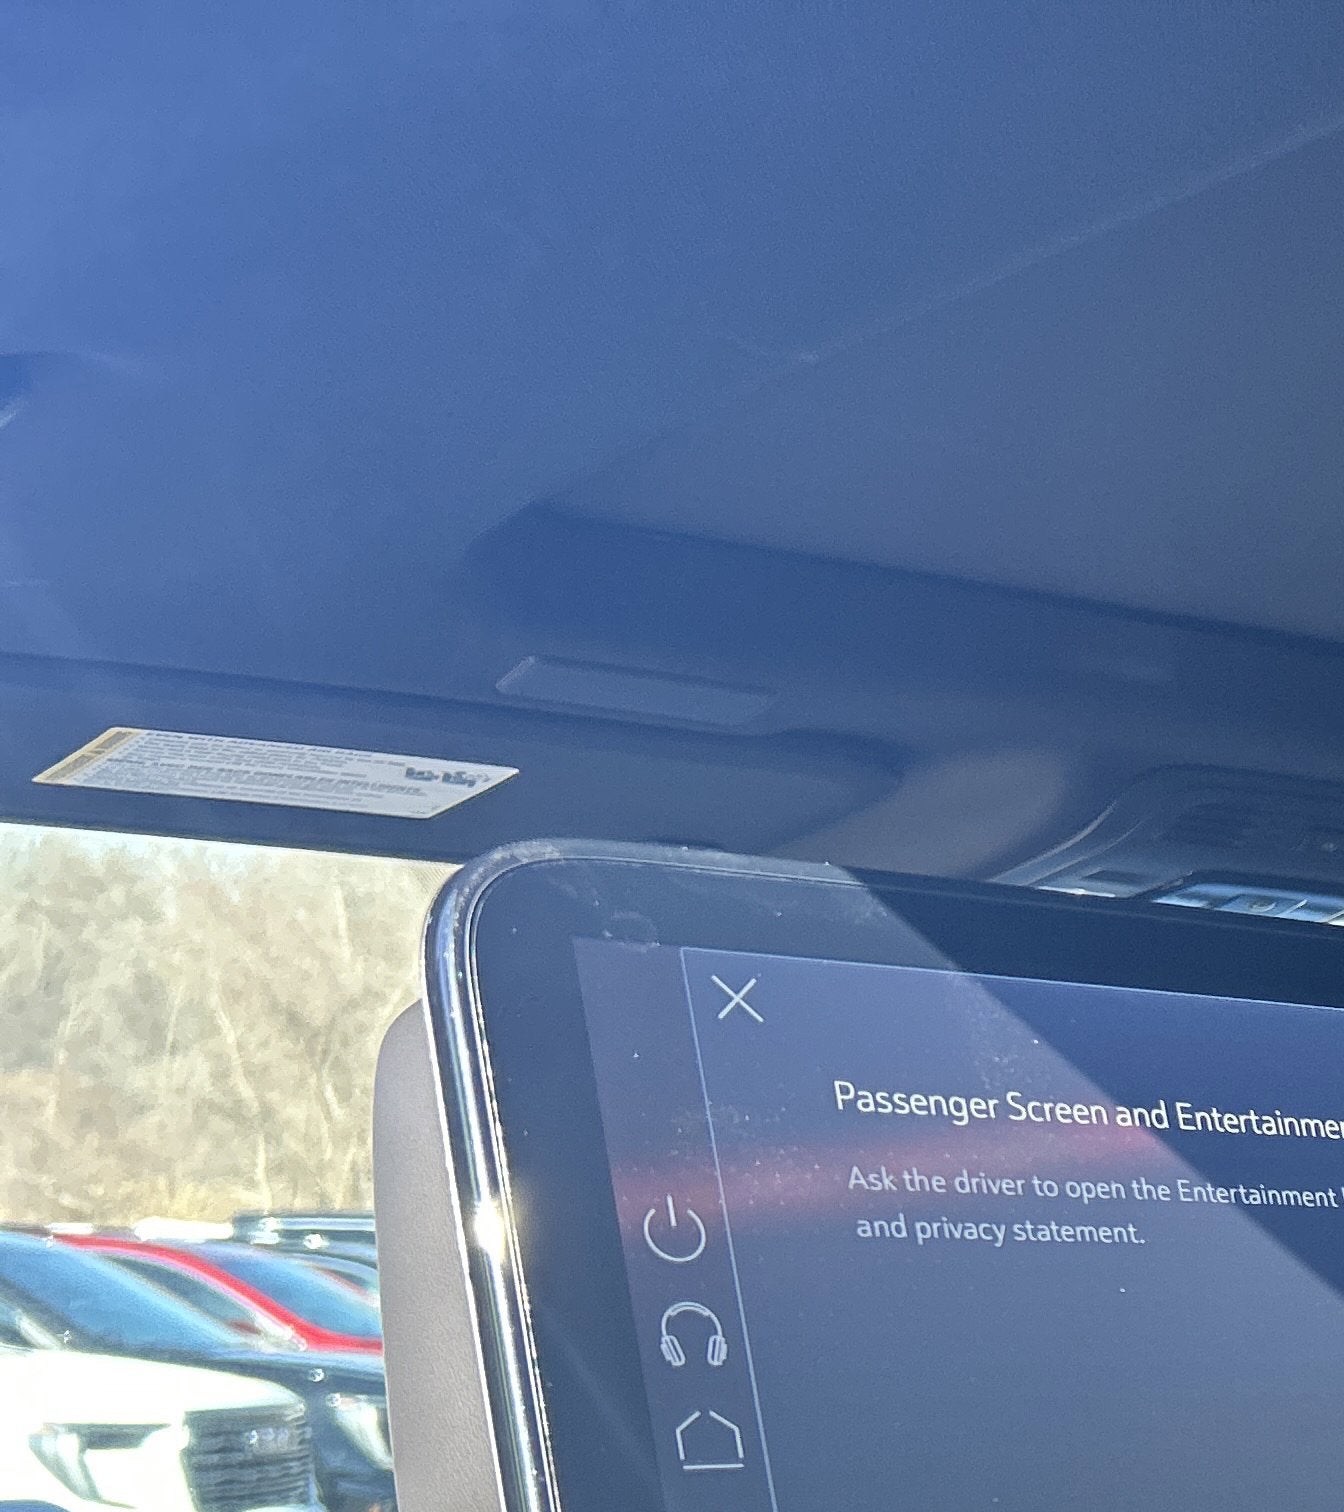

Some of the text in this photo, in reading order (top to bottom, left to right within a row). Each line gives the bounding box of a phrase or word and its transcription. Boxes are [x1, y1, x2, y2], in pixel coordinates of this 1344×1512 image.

[833, 1080, 999, 1126] Passenger
[1006, 1091, 1109, 1125] Screen
[1115, 1099, 1170, 1129] and
[848, 1165, 898, 1191] Ask
[902, 1167, 946, 1193] the
[953, 1168, 1025, 1196] driver
[1032, 1175, 1059, 1198] to
[1065, 1179, 1126, 1204] open
[1131, 1177, 1171, 1201] the
[1176, 1179, 1339, 1208] Entertainment
[856, 1213, 1146, 1247] and privacy statement.
